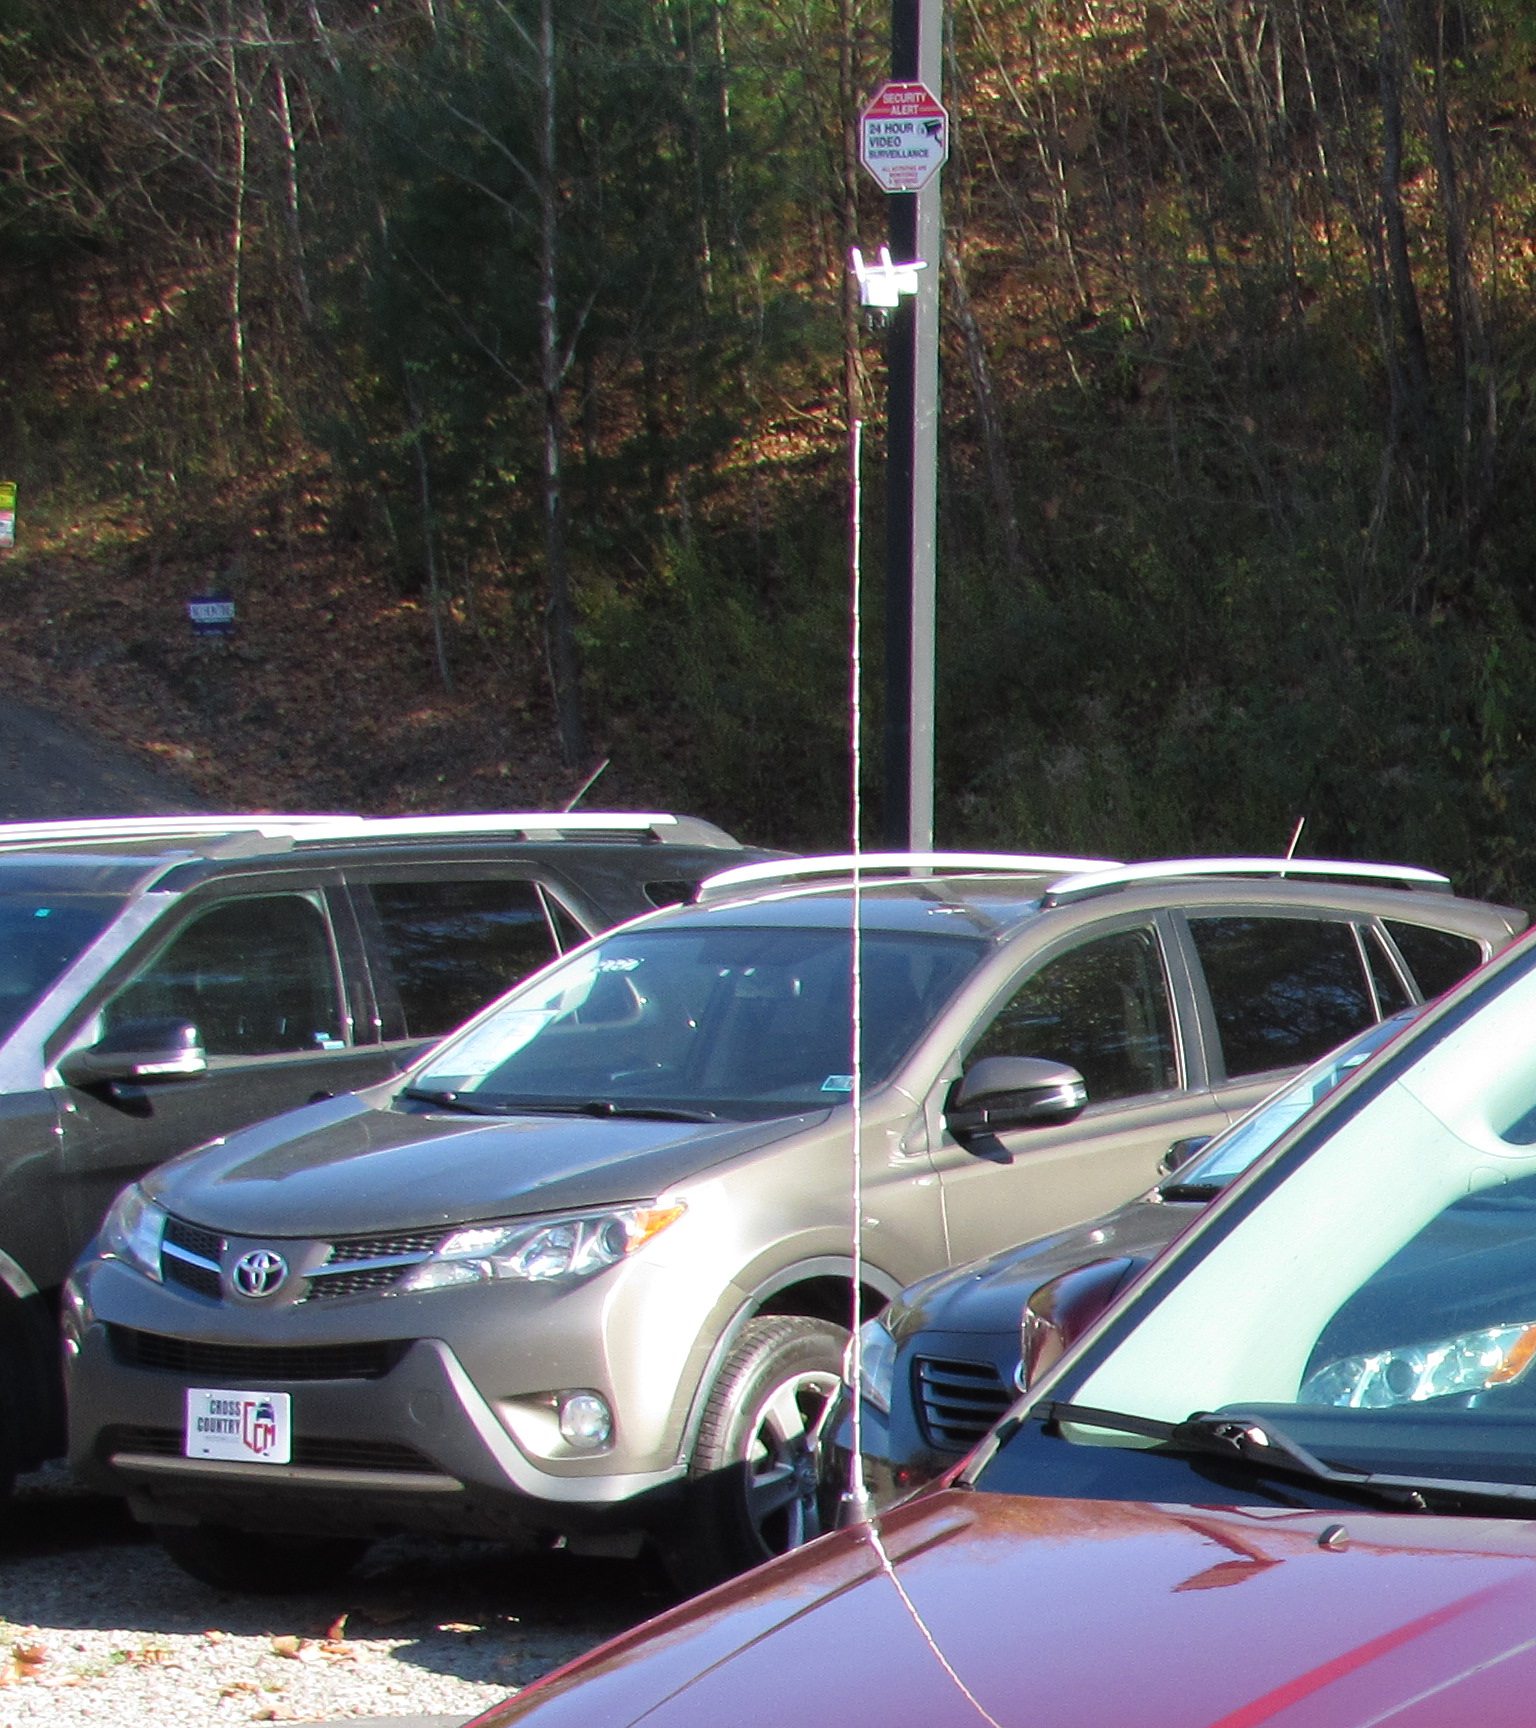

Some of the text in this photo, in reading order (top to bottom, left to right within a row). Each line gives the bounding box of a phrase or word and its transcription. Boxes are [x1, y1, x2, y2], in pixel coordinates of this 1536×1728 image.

[882, 92, 927, 104] SECURITY
[890, 104, 919, 115] ALERT
[869, 122, 914, 134] 24 HOUR
[869, 135, 902, 147] VIDEO
[868, 149, 929, 159] SURVEILLANCE
[210, 1399, 241, 1416] CROSS
[197, 1417, 240, 1434] COUNTRY
